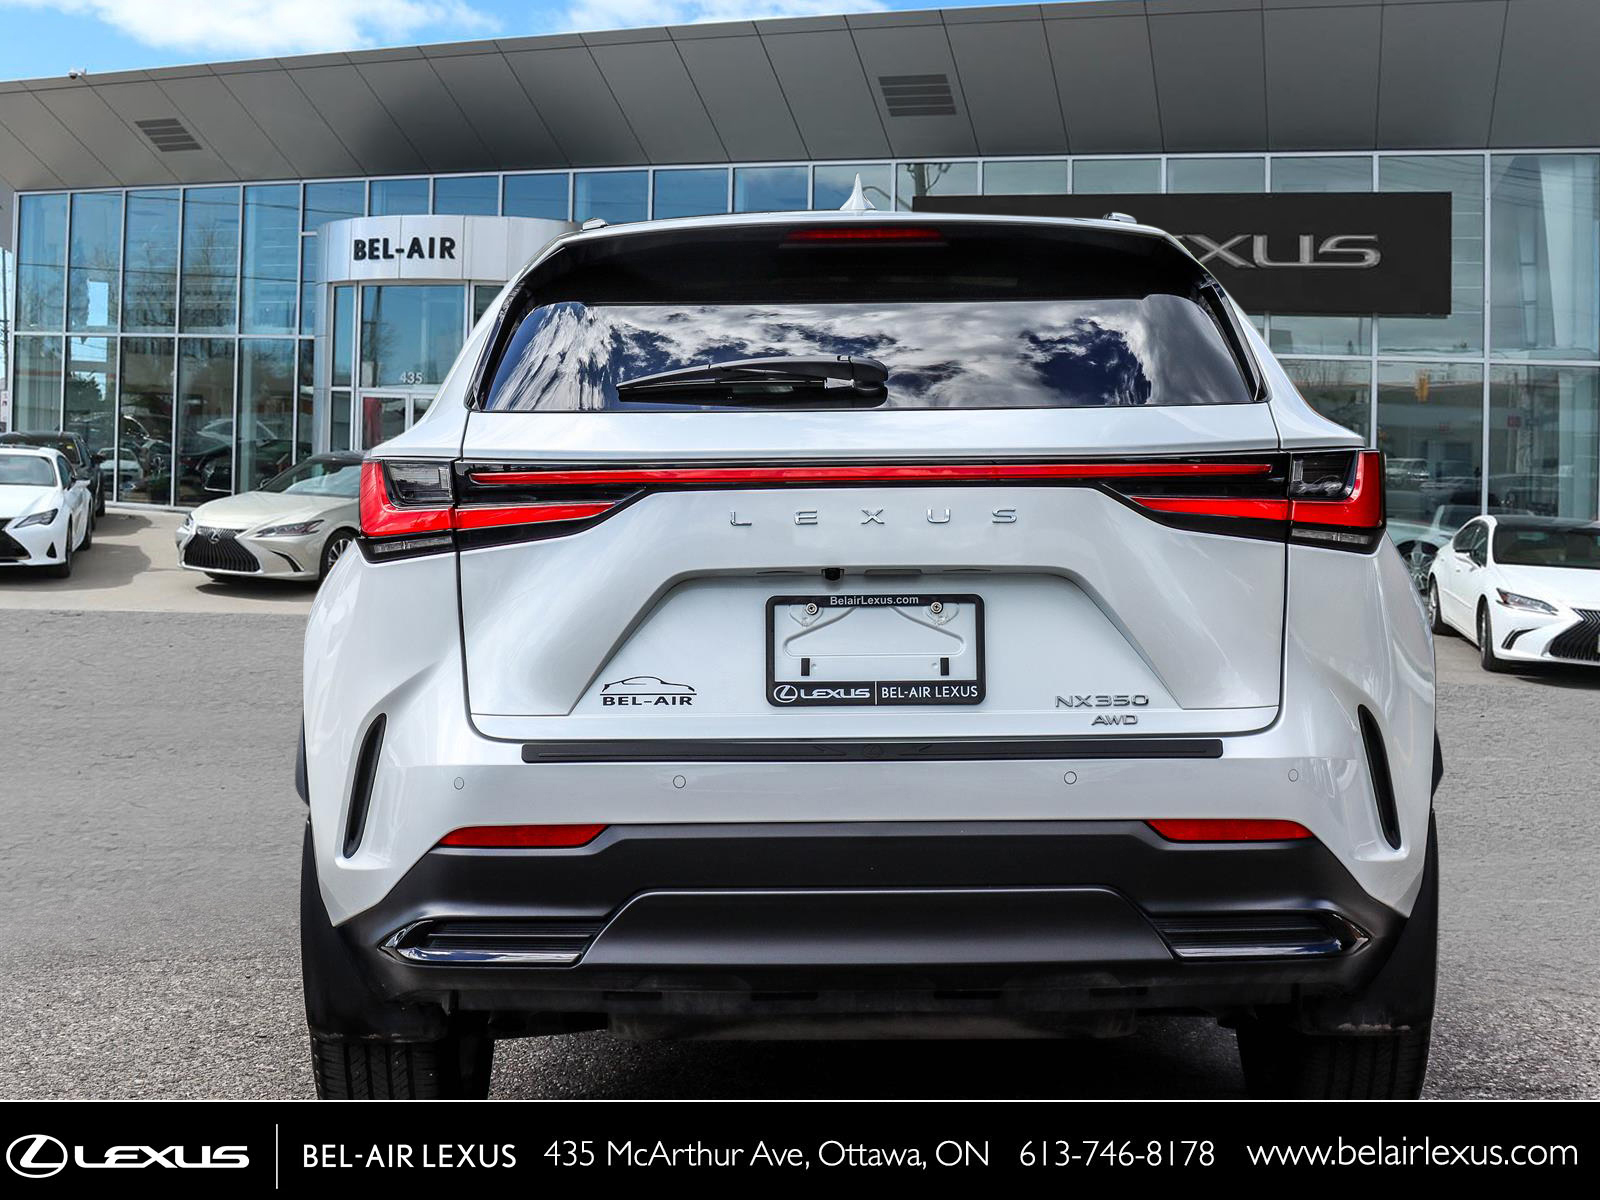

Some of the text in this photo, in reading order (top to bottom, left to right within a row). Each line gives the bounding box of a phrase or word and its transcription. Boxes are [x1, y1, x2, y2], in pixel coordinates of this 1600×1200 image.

[353, 236, 457, 261] BEL-AIR
[1172, 233, 1382, 269] XUS
[400, 370, 424, 385] 435
[729, 508, 1018, 526] LEXUS
[829, 595, 920, 606] BelairLexus.com
[800, 687, 871, 700] LEXUS
[881, 685, 979, 699] BEL-AIR LEXUS
[602, 696, 694, 706] BEL-AIR
[1055, 694, 1150, 708] NX350
[1091, 714, 1138, 726] AWD
